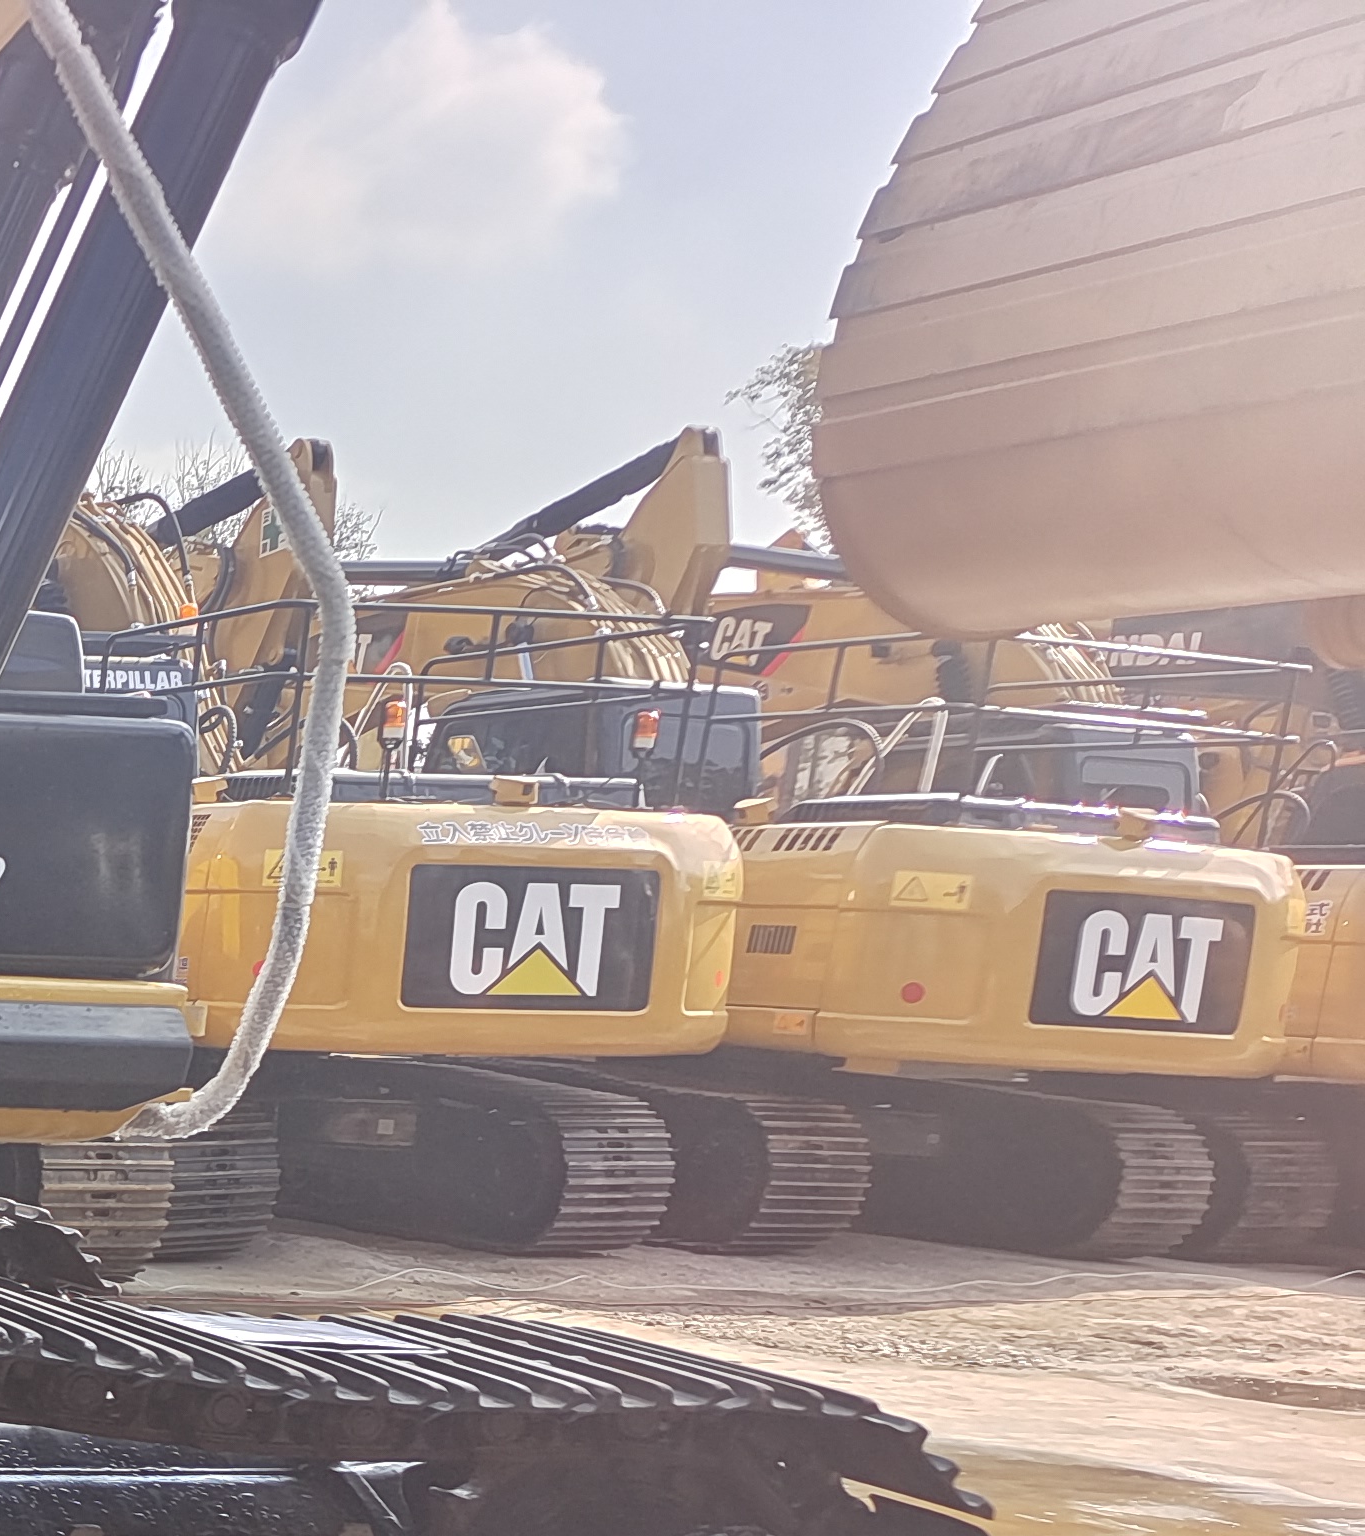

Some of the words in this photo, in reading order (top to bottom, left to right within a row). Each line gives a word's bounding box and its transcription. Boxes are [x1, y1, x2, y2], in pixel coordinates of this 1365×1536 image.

[711, 616, 774, 667] CAT
[449, 881, 620, 998] CAT
[1072, 909, 1223, 1023] CAT
